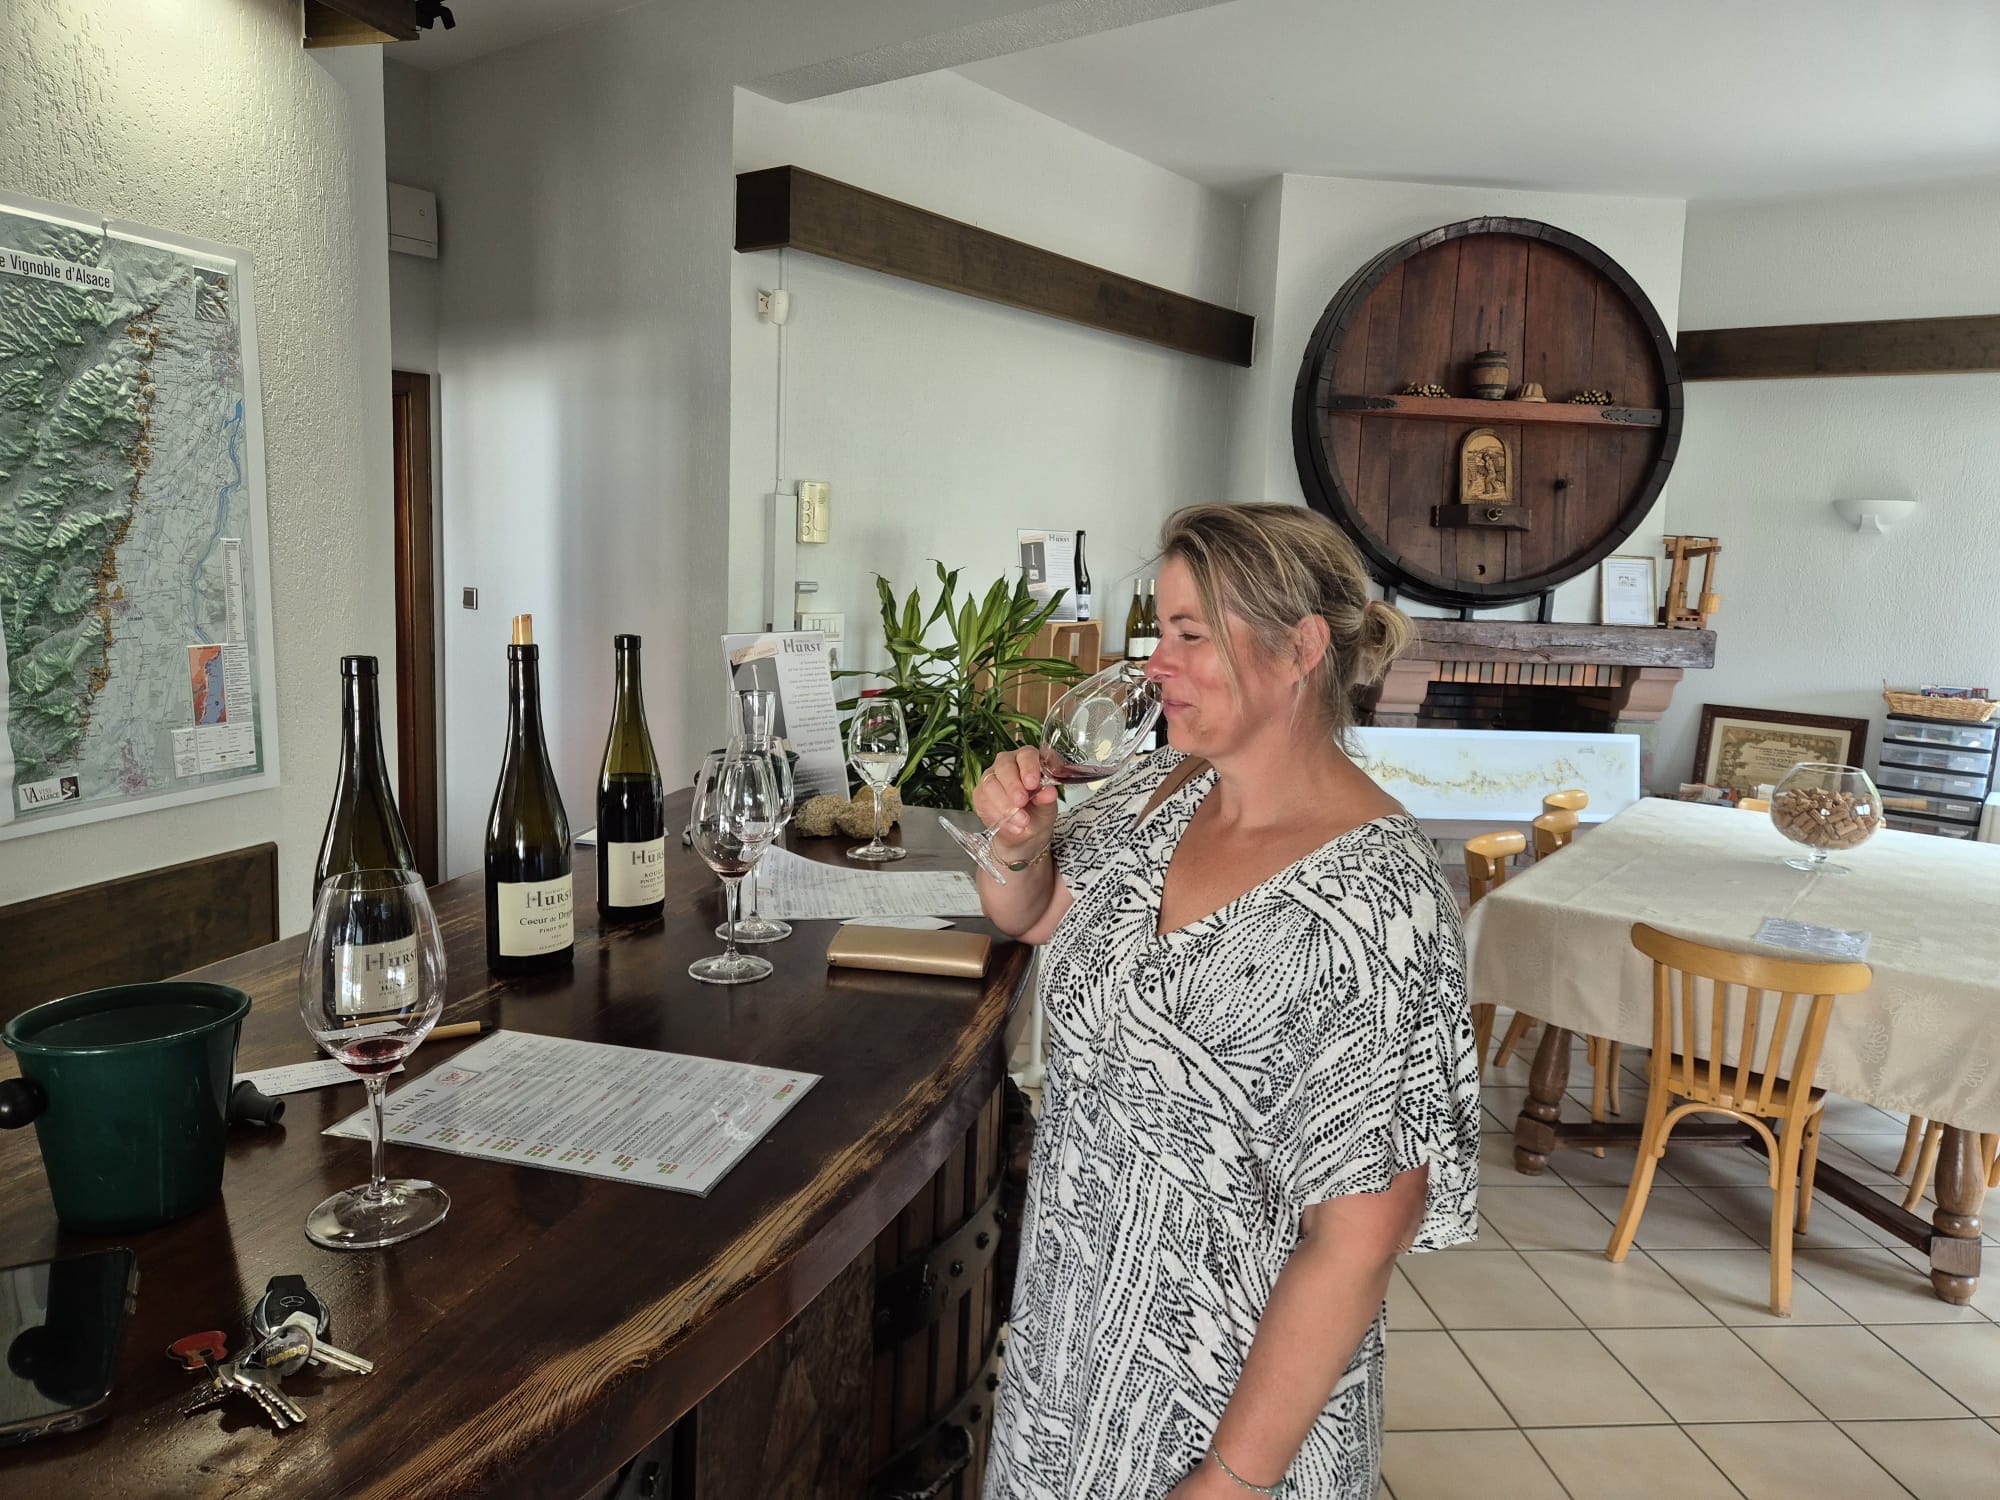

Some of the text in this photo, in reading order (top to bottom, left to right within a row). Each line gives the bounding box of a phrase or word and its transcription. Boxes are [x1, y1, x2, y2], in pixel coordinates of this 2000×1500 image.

[10, 254, 61, 278] Vignoble
[65, 266, 110, 288] d'Alsace
[519, 917, 548, 926] Coeur
